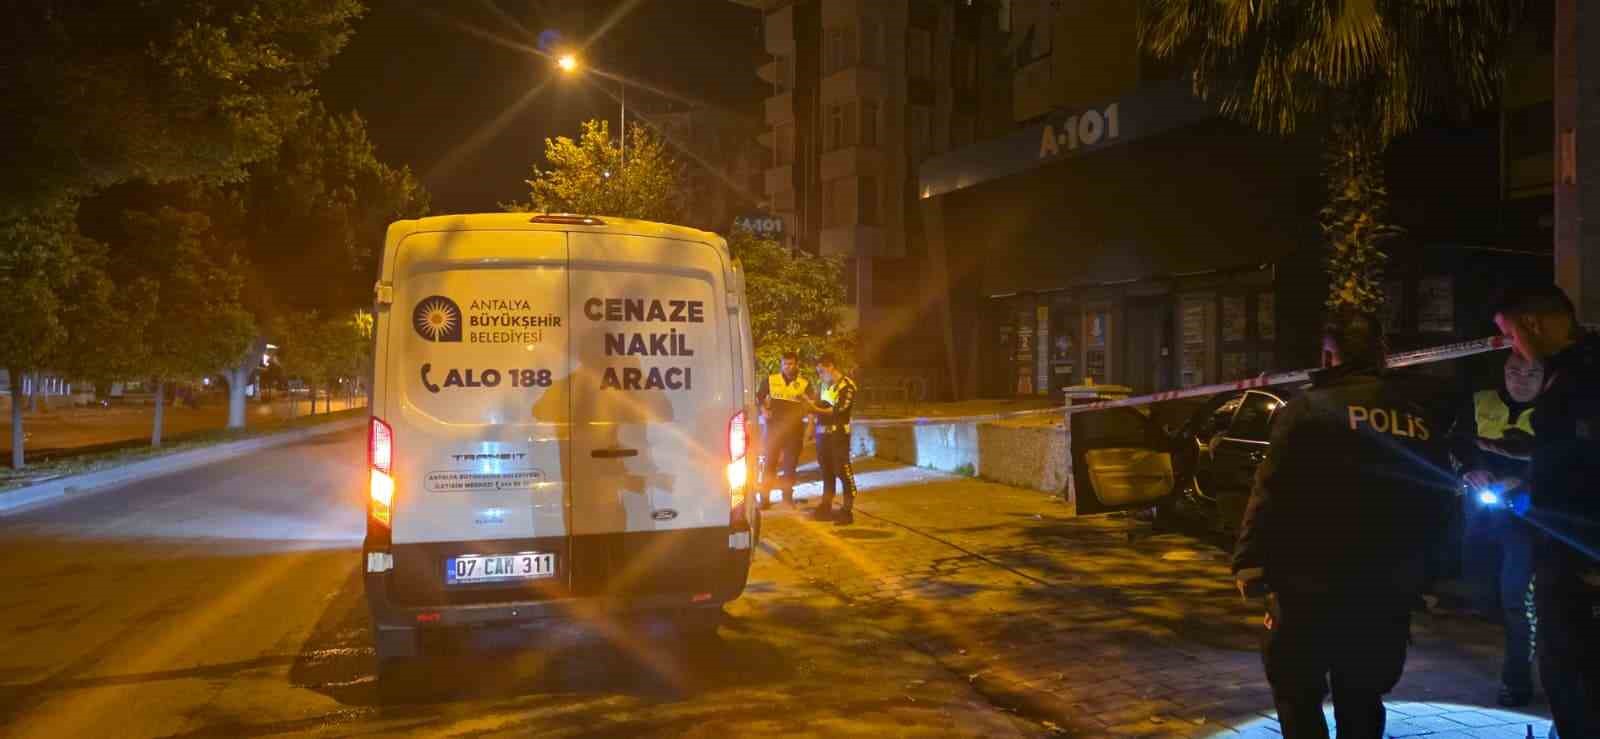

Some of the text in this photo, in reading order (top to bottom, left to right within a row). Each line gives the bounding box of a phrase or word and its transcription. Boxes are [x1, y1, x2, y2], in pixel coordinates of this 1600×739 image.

[470, 299, 531, 311] ANTALYA
[584, 298, 704, 323] CENAZE
[470, 313, 561, 330] BÜYÜKŞEHİR
[470, 329, 543, 345] BELEDİYESİ
[605, 327, 694, 356] NAKİL
[443, 367, 552, 388] ALO 188
[600, 366, 691, 391] ARACI
[1347, 405, 1430, 441] POLİS
[457, 559, 476, 577] 07
[522, 555, 551, 573] 311
